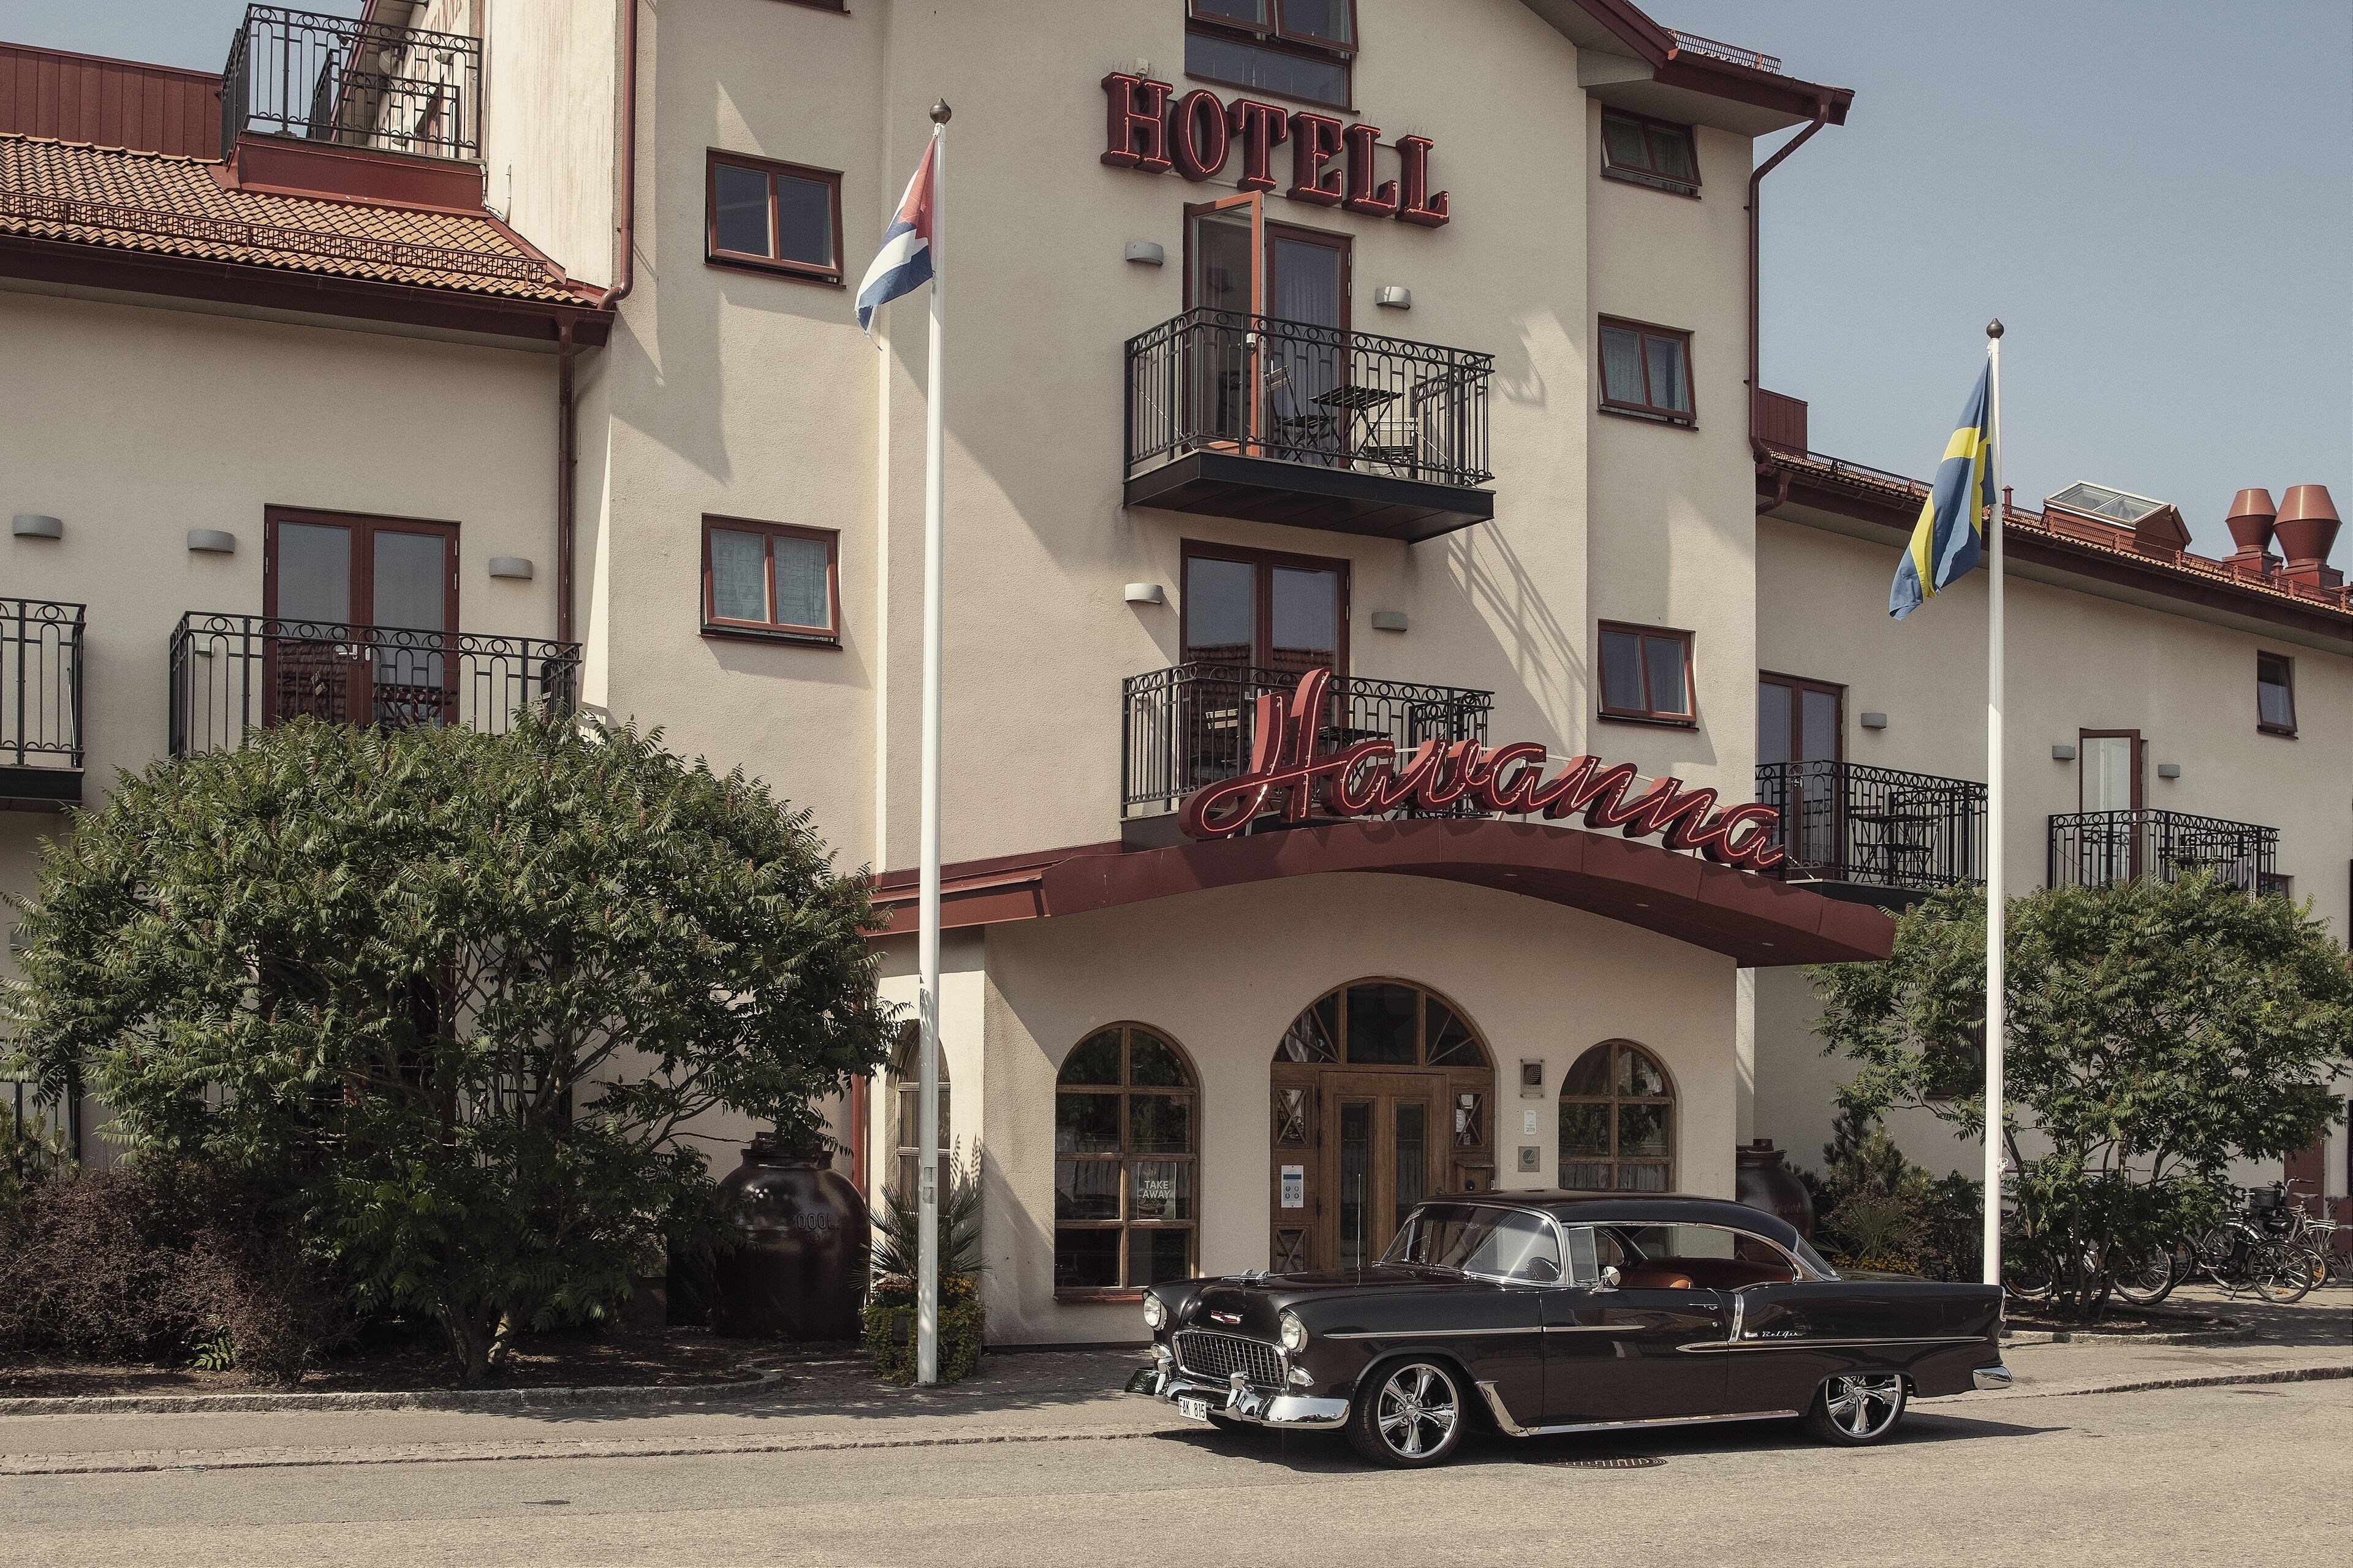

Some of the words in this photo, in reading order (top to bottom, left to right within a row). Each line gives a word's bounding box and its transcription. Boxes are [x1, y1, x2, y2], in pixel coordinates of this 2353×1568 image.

[1101, 72, 1450, 228] HOTELL
[1180, 668, 1784, 870] Havanna
[1144, 1180, 1169, 1189] TAKE
[1142, 1190, 1171, 1199] AWAY
[1180, 1399, 1191, 1415] FAK
[1194, 1402, 1205, 1418] 815
